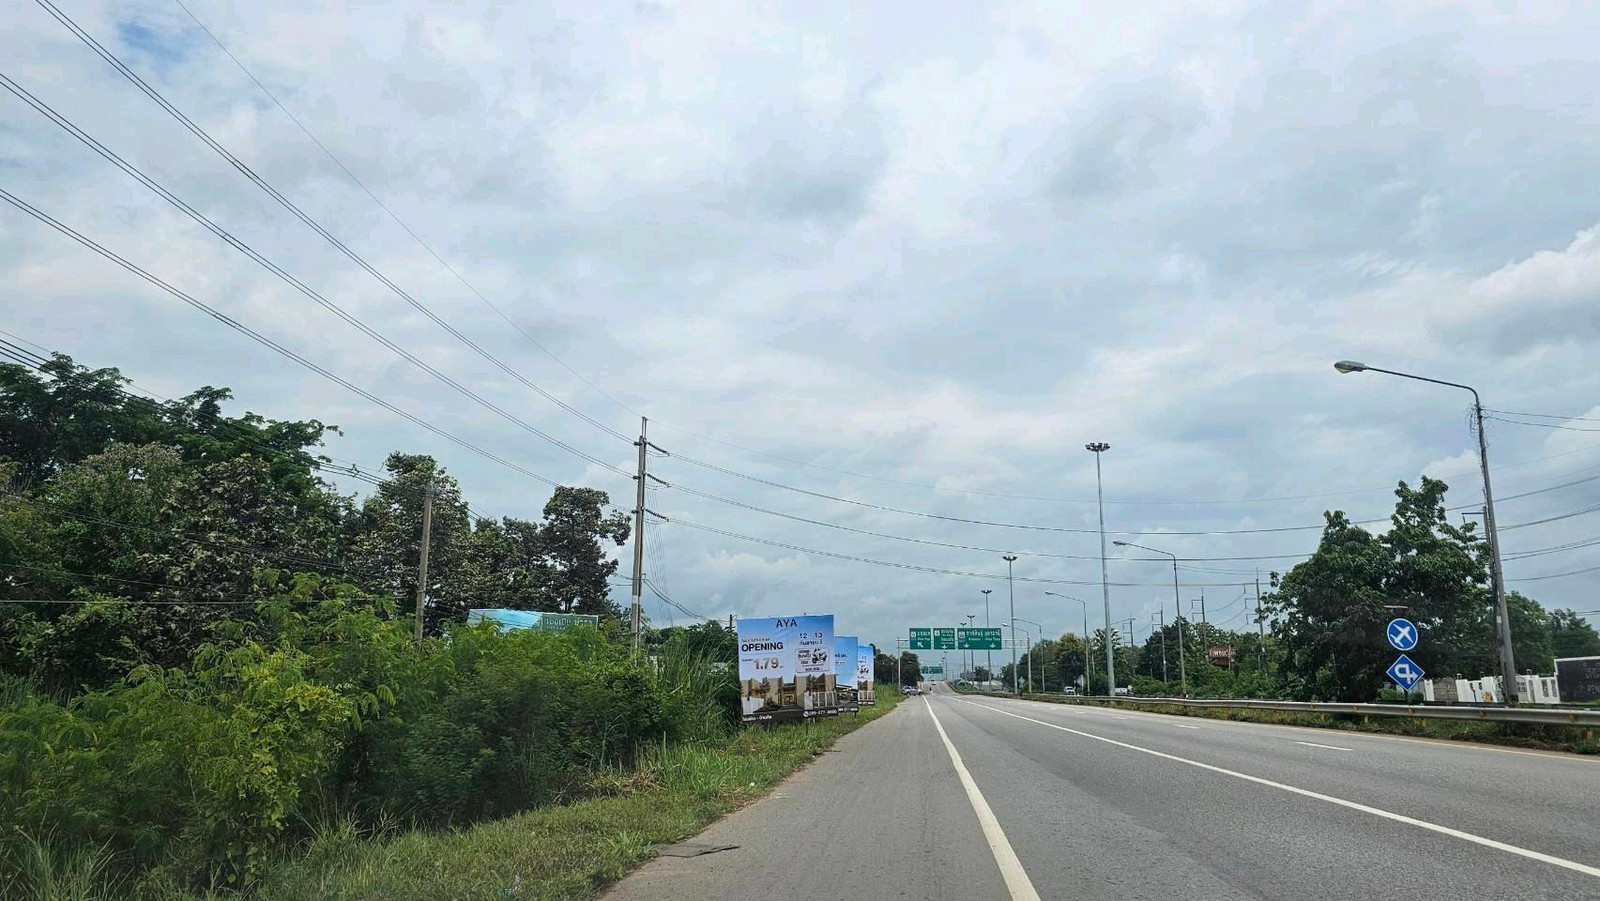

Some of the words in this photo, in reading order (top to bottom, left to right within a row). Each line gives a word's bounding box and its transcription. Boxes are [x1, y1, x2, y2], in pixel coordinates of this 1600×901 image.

[776, 619, 797, 628] AYA
[742, 642, 783, 652] OPENING
[753, 657, 779, 669] 1.79
